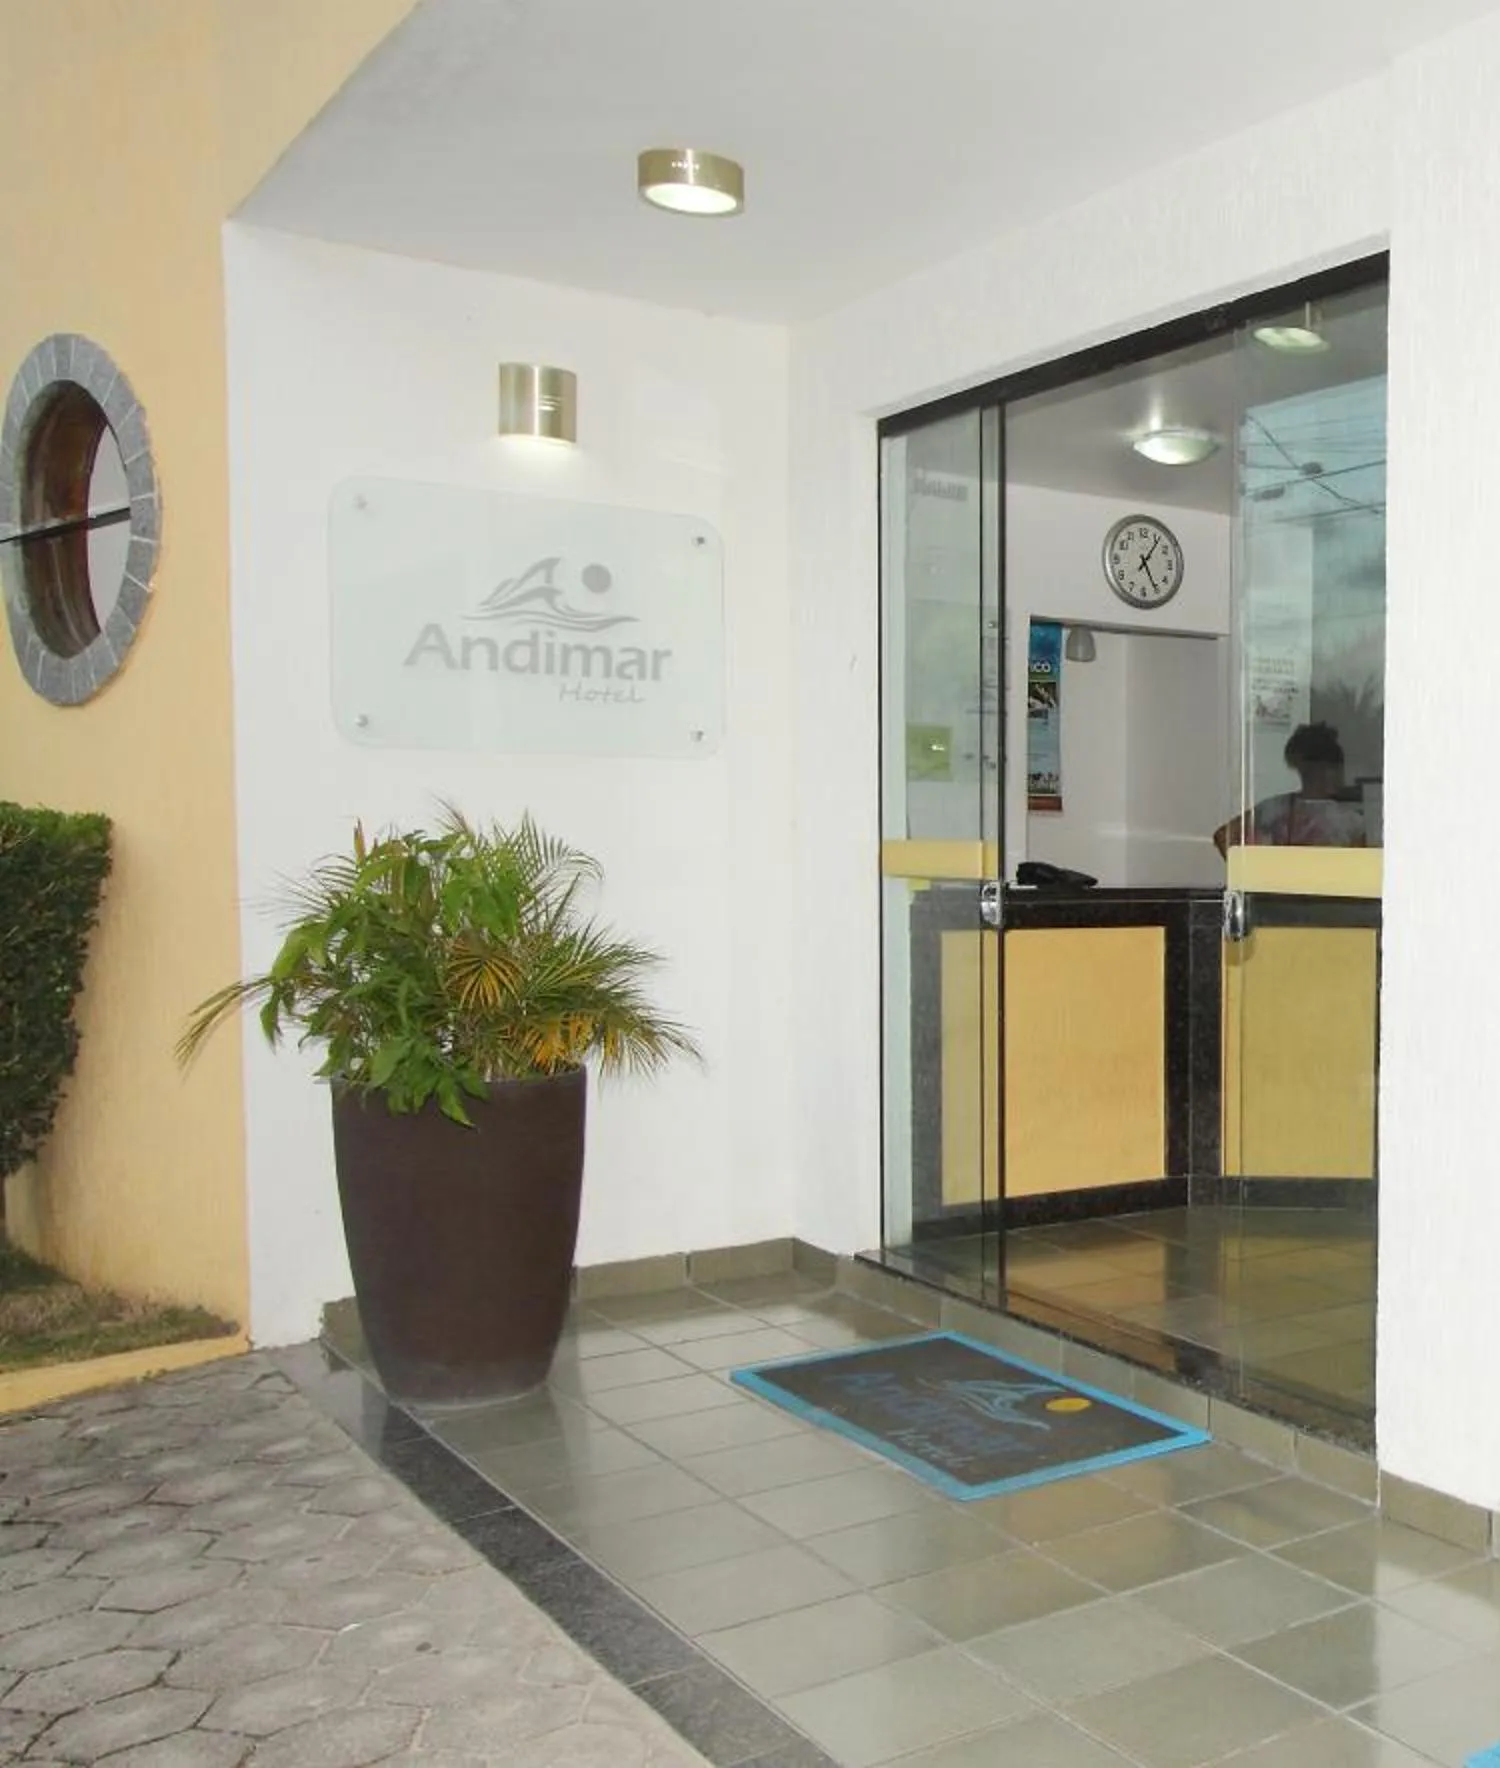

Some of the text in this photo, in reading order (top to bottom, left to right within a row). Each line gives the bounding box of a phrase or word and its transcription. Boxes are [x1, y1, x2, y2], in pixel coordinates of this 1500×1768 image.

[1138, 527, 1149, 539] 12
[403, 622, 673, 681] Andimar
[558, 681, 646, 704] Hotel
